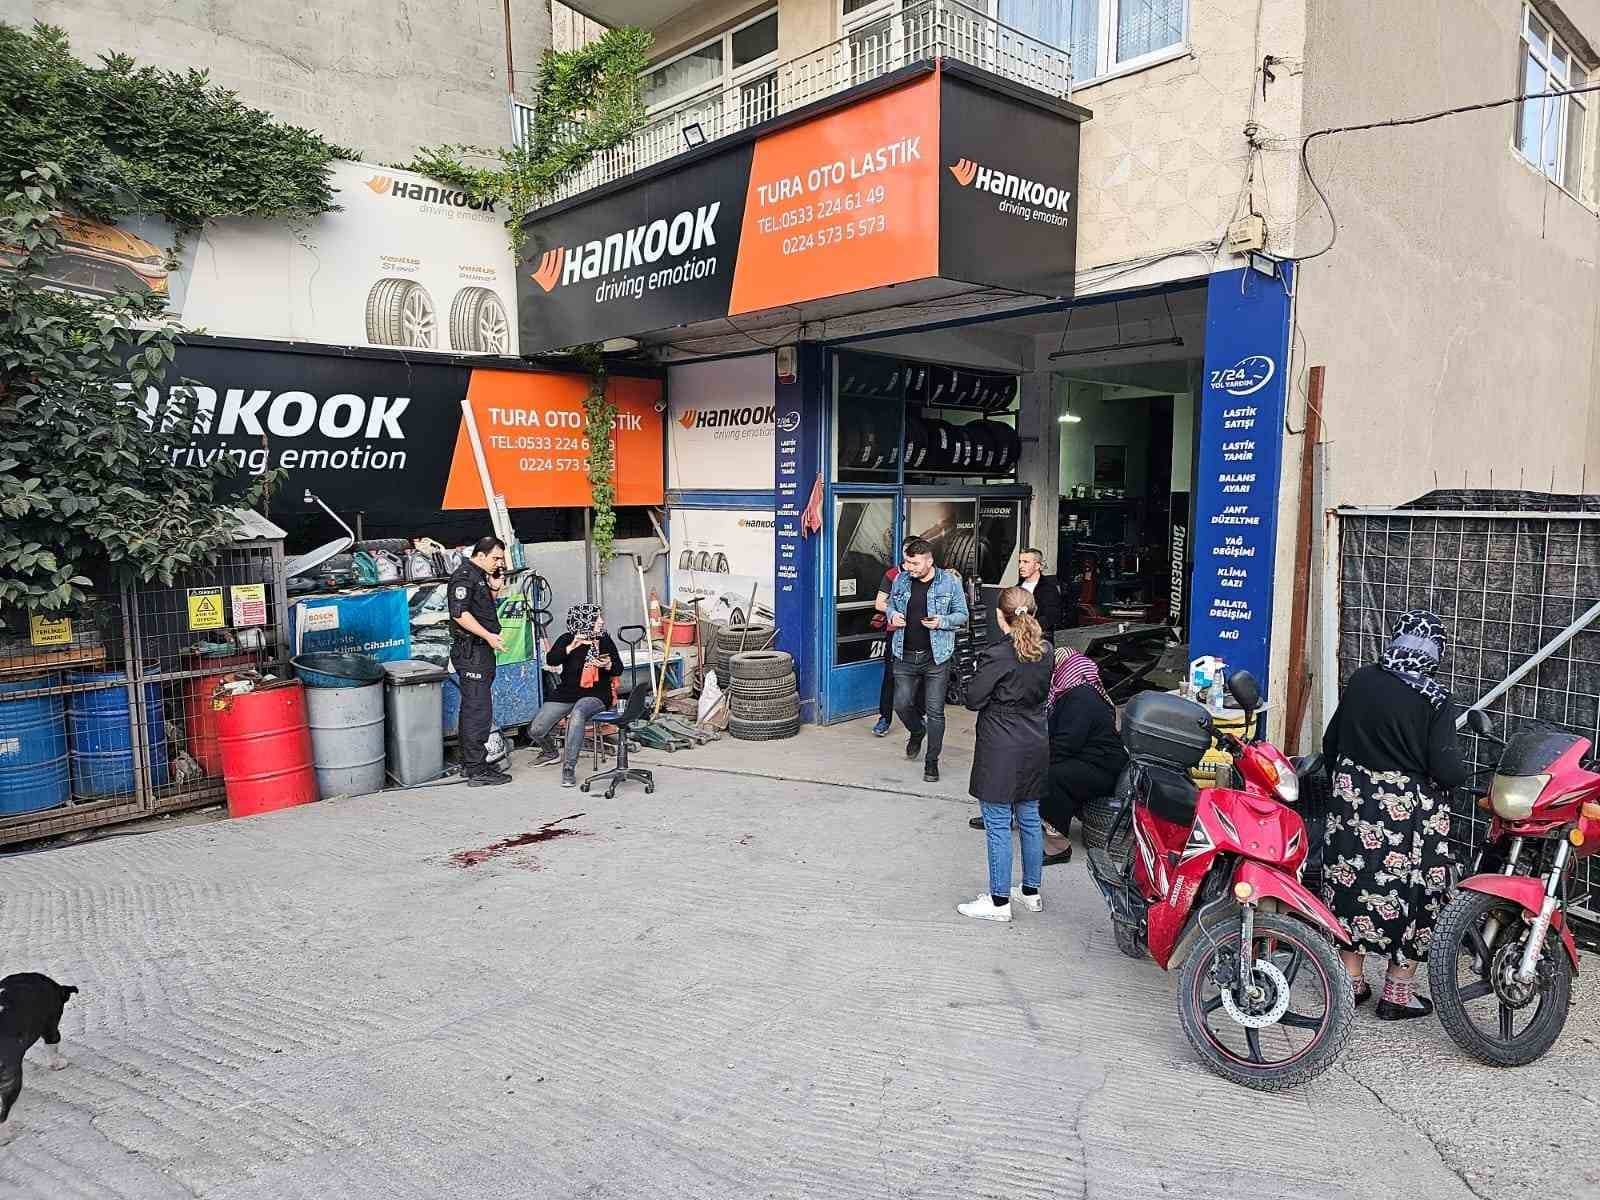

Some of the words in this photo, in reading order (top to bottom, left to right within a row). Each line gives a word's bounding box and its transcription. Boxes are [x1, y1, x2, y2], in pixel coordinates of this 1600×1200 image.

[757, 175, 804, 208] TURA
[807, 161, 845, 192] OTO
[851, 136, 921, 180] LASTİK
[757, 206, 814, 235] TEL:0533
[817, 198, 841, 219] 224
[845, 191, 862, 210] 61
[865, 185, 885, 205] 49
[999, 200, 1031, 221] driving
[1032, 209, 1069, 228] emotion
[782, 236, 814, 257] 0224
[817, 226, 843, 247] 573
[847, 223, 856, 240] 5
[859, 215, 885, 237] 573
[595, 274, 645, 304] driving
[648, 256, 717, 290] emotion
[1210, 368, 1246, 383] 7/24
[1223, 406, 1258, 417] LASTİK
[488, 408, 540, 427] TURA
[545, 410, 581, 428] OTO
[1224, 418, 1255, 430] SATIŞI
[490, 436, 552, 450] TEL:0533
[556, 437, 578, 450] 224
[1222, 440, 1256, 451] LASTİK
[280, 444, 407, 470] emotion
[1224, 450, 1253, 461] TAMİR
[519, 457, 553, 472] 0224
[556, 458, 580, 471] 573
[1219, 474, 1256, 482] BALANS
[1222, 484, 1250, 493] AYARI
[1223, 505, 1248, 514] JANT
[1211, 514, 1260, 525] DÜZELTME
[1225, 536, 1243, 546] YAĞ
[1212, 546, 1256, 557] DEĞİŞİMİ
[1217, 567, 1247, 577] KLİMA
[1221, 579, 1243, 587] GAZI
[1214, 599, 1248, 609] BALATA
[1209, 609, 1252, 620] DEĞİŞİMİ
[1219, 630, 1239, 640] AKÜ
